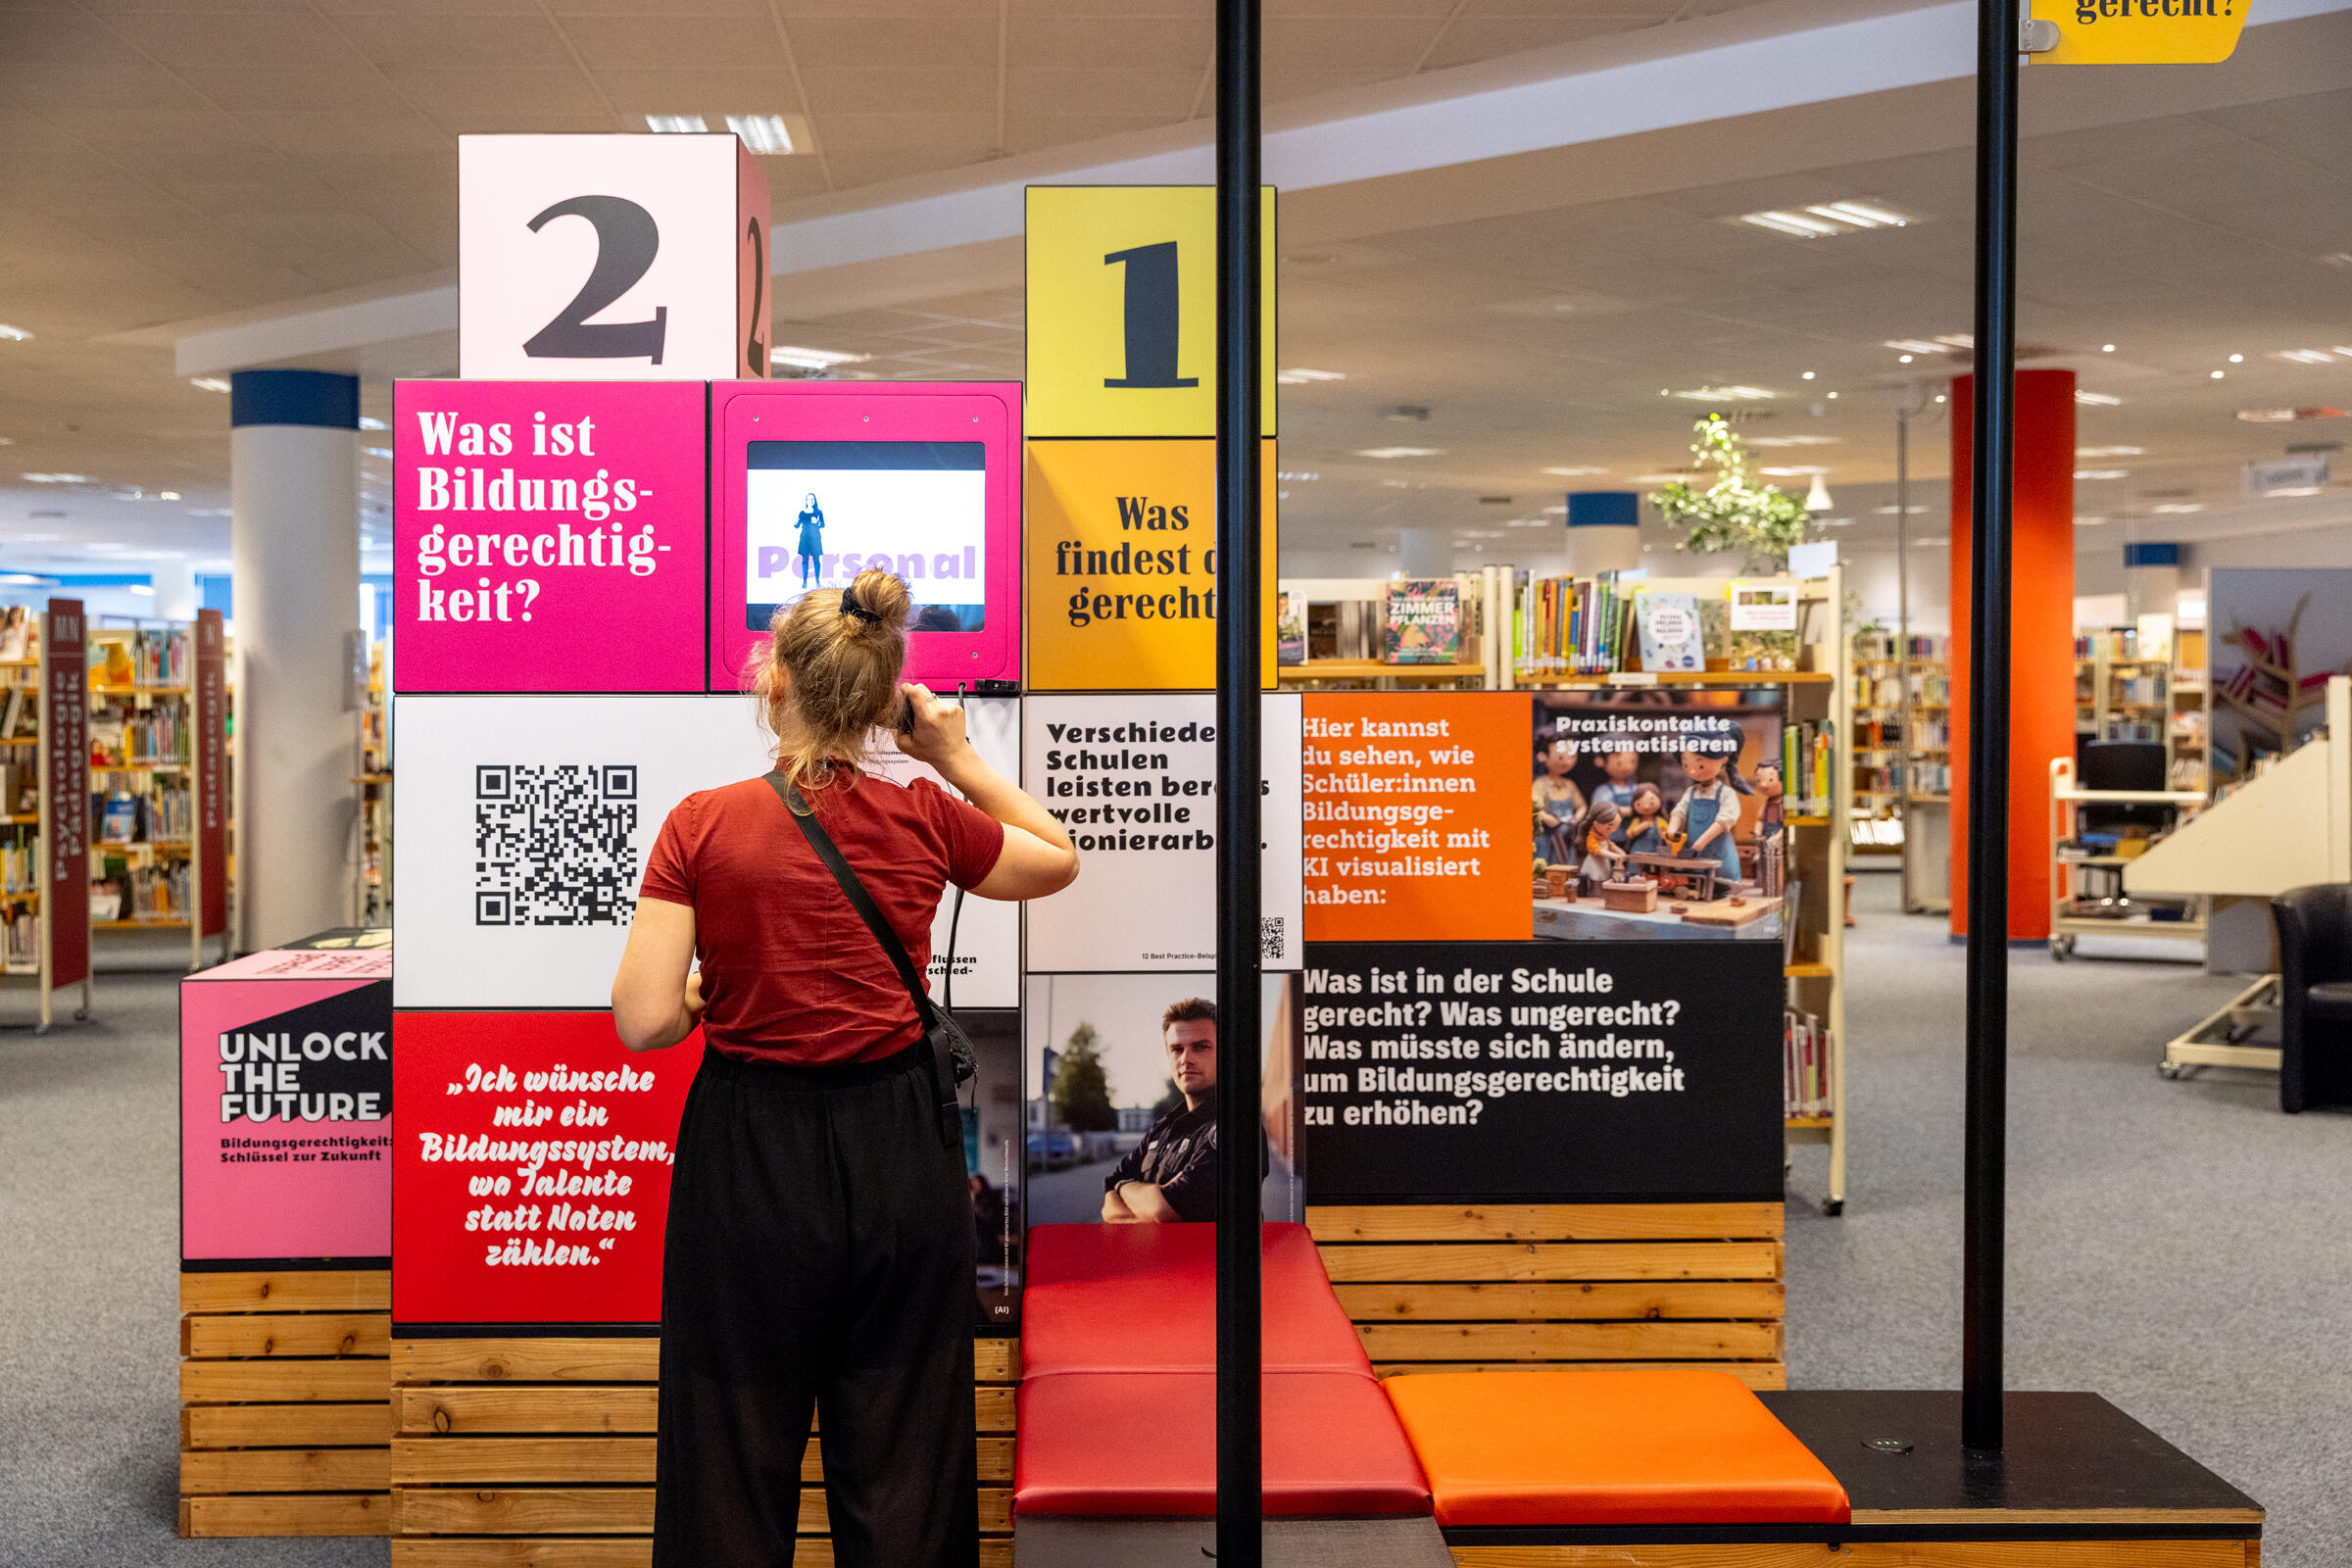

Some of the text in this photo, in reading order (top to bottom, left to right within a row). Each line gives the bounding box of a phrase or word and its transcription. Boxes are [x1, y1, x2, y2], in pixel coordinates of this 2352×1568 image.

[522, 194, 667, 366] 2
[747, 216, 764, 378] 2
[1104, 241, 1200, 388] 1
[416, 411, 596, 457] Was ist
[417, 466, 654, 520] Bildungs-
[1116, 497, 1189, 530] Was
[417, 524, 672, 576] gerechtig-
[758, 545, 976, 579] Personal
[1055, 541, 1191, 575] findest
[417, 579, 541, 622] keit?
[1068, 587, 1217, 628] gerecht
[1390, 601, 1455, 614] ZIMMER
[1390, 614, 1455, 625] PFLANZEN
[1046, 721, 1216, 743] Verschiede
[1302, 716, 1449, 738] Hier kannst
[1556, 715, 1731, 734] Praxiskontakte
[1047, 750, 1168, 770] Schulen
[1302, 746, 1475, 769] du sehen, wie
[1556, 735, 1738, 755] systematisieren
[53, 670, 70, 881] Psychologie
[1047, 775, 1270, 797] leisten bers
[1302, 771, 1476, 794] Schüler:innen
[1047, 803, 1191, 824] wertvolle
[1302, 802, 1454, 824] Bildungsge-
[1069, 829, 1267, 851] ionierarb.
[1302, 828, 1490, 854] rechtigkeit mit
[1302, 856, 1481, 877] KI visualisiert
[1302, 884, 1387, 905] haben:
[1304, 967, 1613, 994] Was ist in der Schule
[1304, 1000, 1681, 1032] gerecht? Was ungerecht?
[220, 1032, 388, 1062] UNLOCK
[1304, 1033, 1675, 1063] Was müsste sich ändern,
[220, 1062, 300, 1093] THE
[446, 1062, 656, 1096] „Ich wünsche
[1304, 1065, 1685, 1098] um Bildungsgerechtigkeit
[220, 1092, 381, 1123] FUTURE
[493, 1099, 609, 1127] mir ein
[1304, 1099, 1484, 1126] zu erhöhen?
[220, 1151, 381, 1162] Schlüssel zur Zukunft
[418, 1132, 674, 1171] Bildungssystem,
[468, 1166, 633, 1197] wo Talente
[465, 1201, 637, 1232] statt Noten
[995, 1305, 1009, 1314] (AI)
